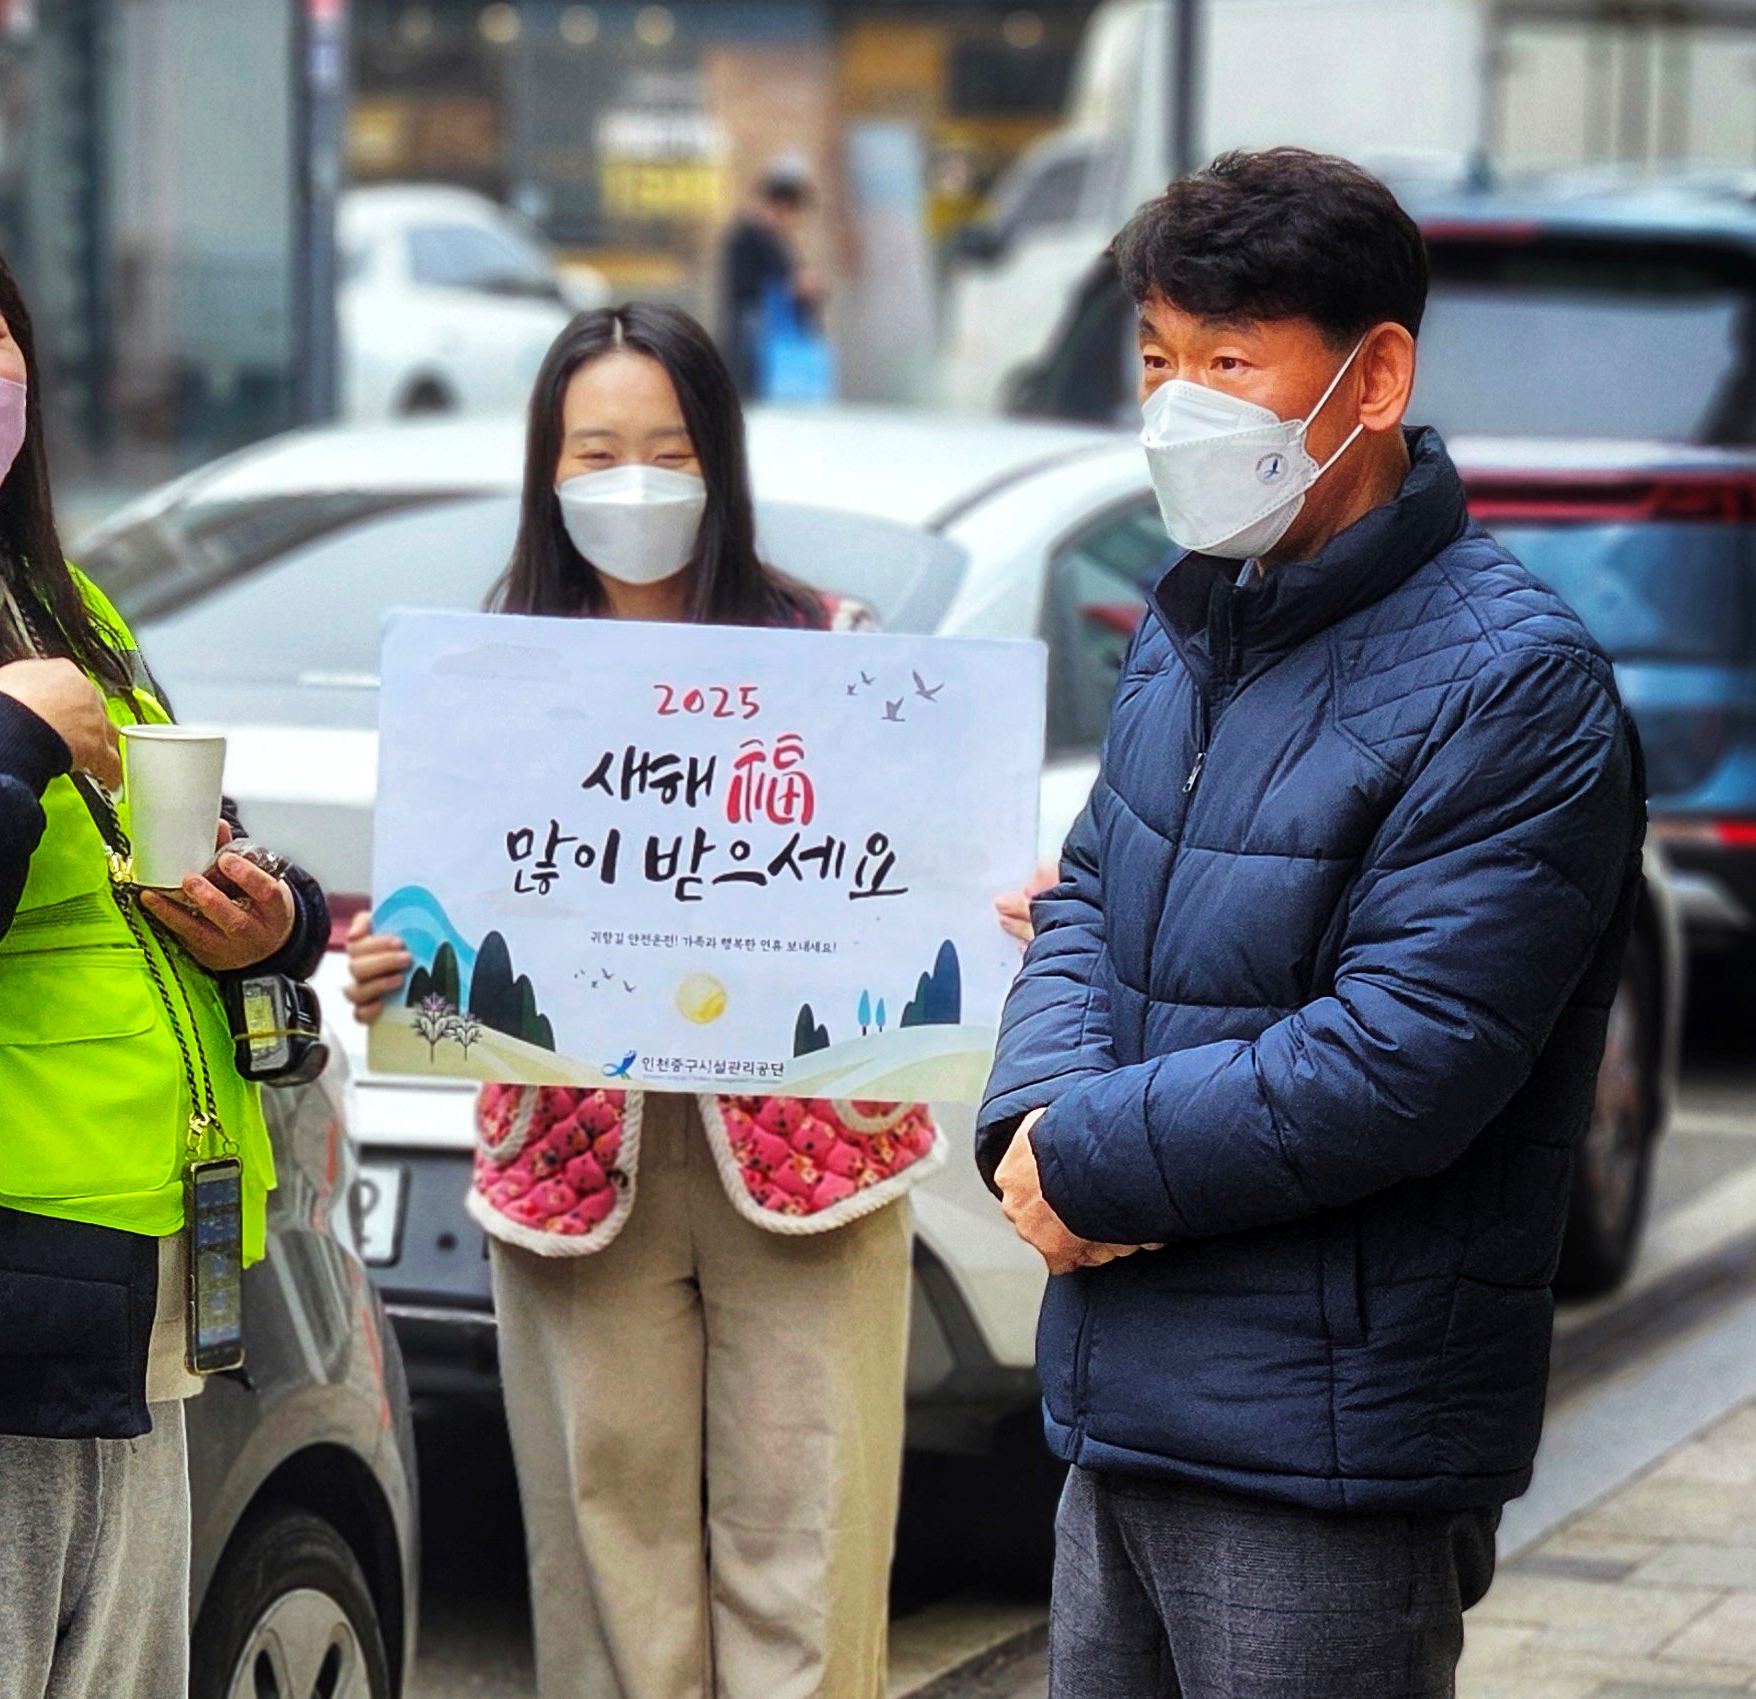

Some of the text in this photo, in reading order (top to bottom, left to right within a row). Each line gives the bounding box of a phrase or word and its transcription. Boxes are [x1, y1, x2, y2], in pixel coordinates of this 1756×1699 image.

[653, 684, 761, 719] 2025
[581, 733, 815, 826] 새해 福
[506, 819, 909, 902] 많이 받으세요
[590, 931, 837, 954] 귀향길 안전운전! 가족과 행복한 연휴 보내세요!
[642, 1056, 785, 1077] 인천중구시설관리공단
